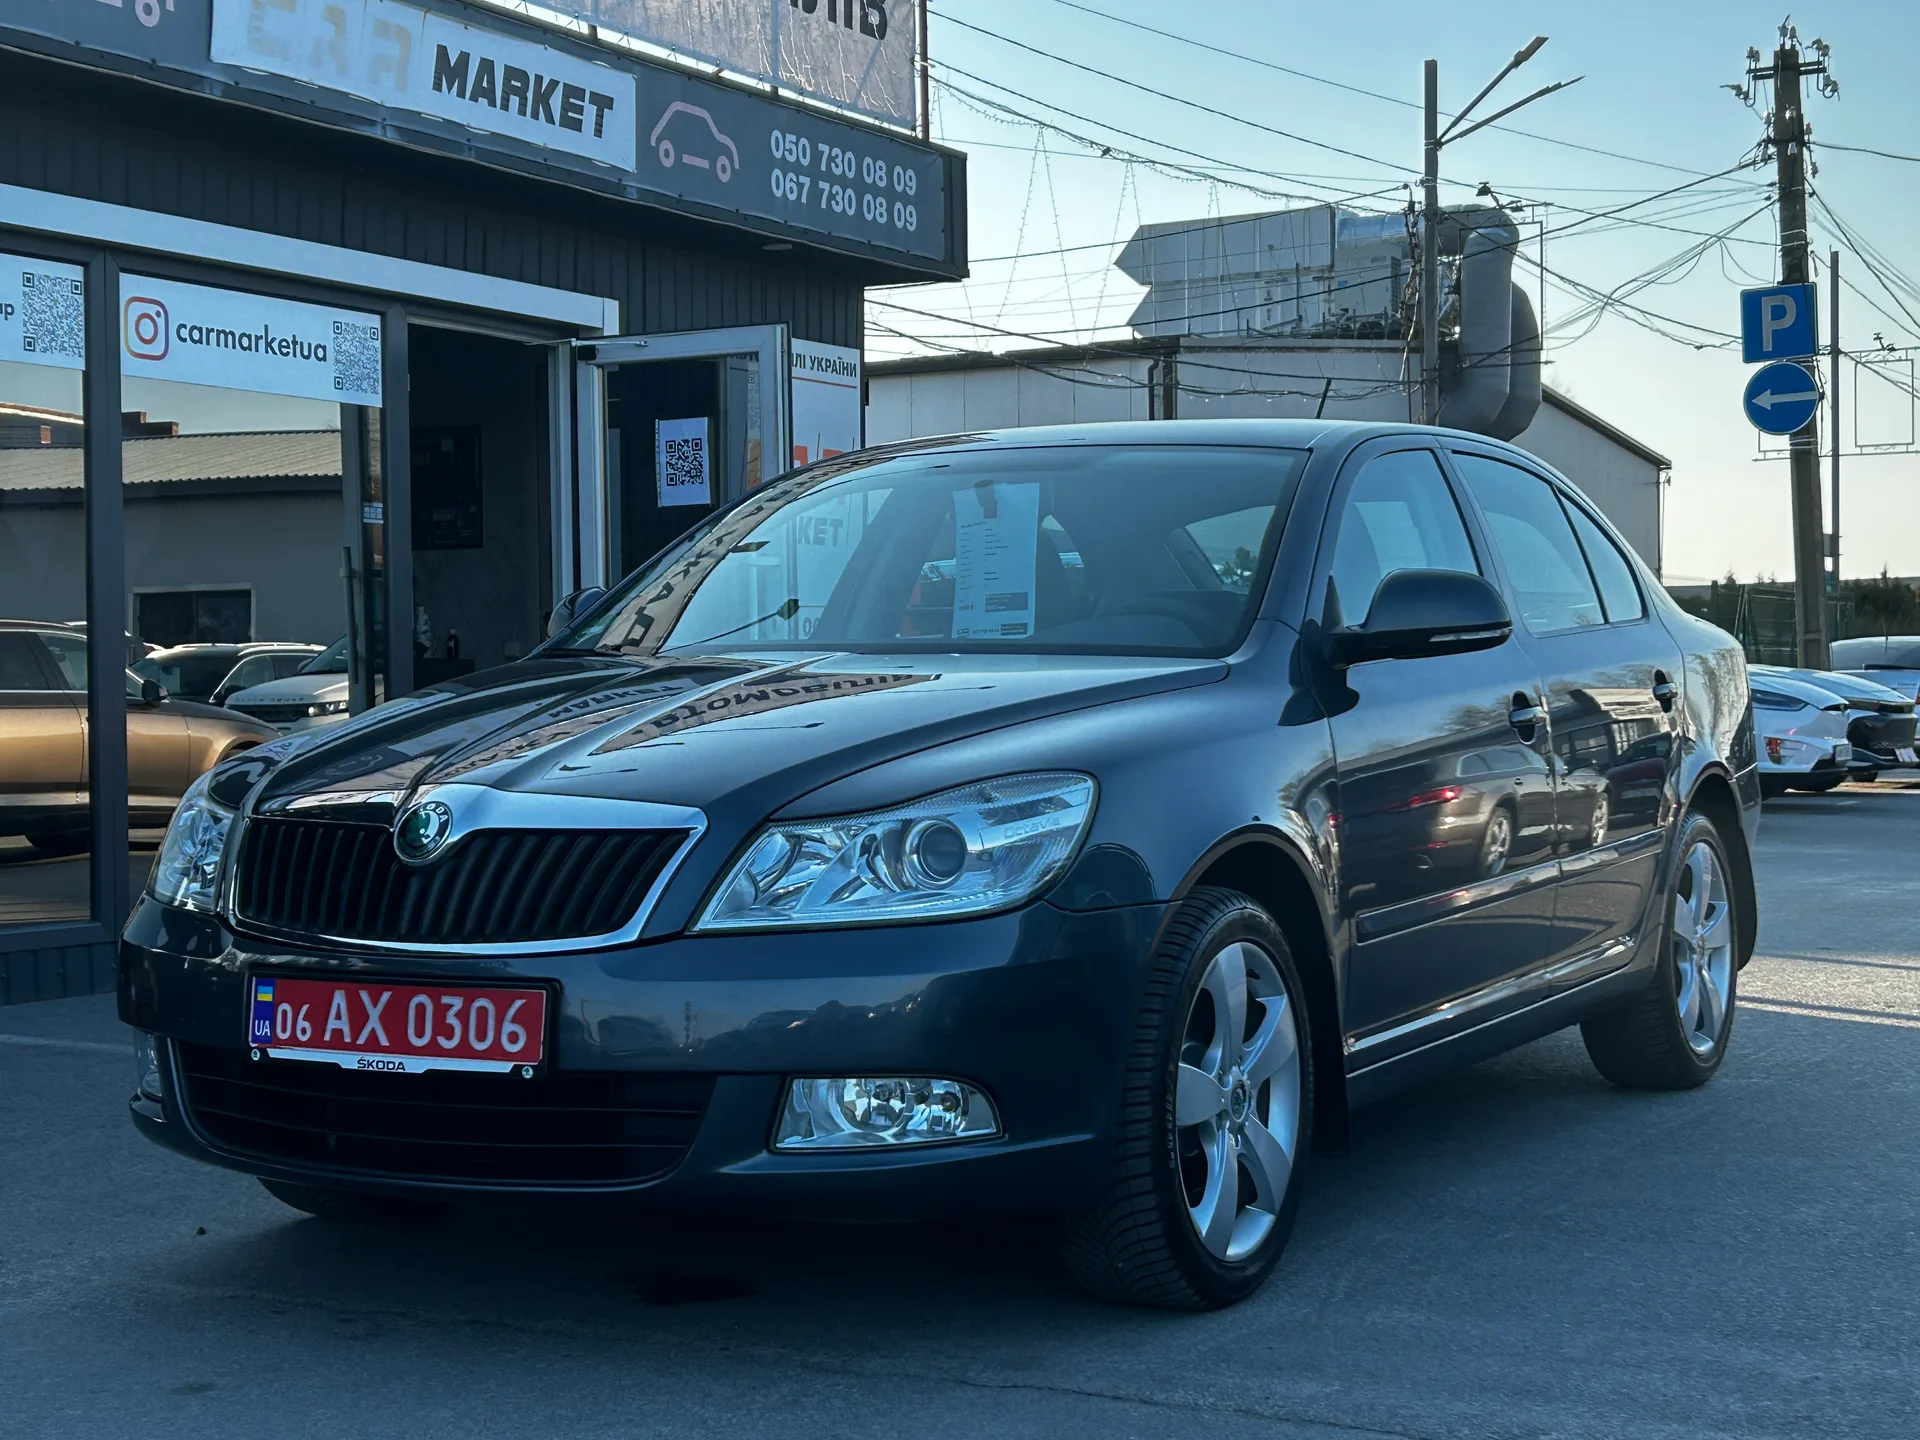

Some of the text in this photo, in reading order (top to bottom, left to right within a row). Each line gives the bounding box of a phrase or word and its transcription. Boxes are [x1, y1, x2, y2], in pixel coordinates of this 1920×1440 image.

[432, 45, 614, 138] MARKET
[771, 130, 917, 197] 050 730 08 09
[771, 168, 917, 231] 067 730 08 09
[175, 319, 328, 363] carmarketua
[1761, 294, 1796, 352] P
[810, 355, 857, 378] УКРАЇНИ
[254, 1019, 271, 1036] UA
[275, 989, 527, 1053] 06 AX 0306
